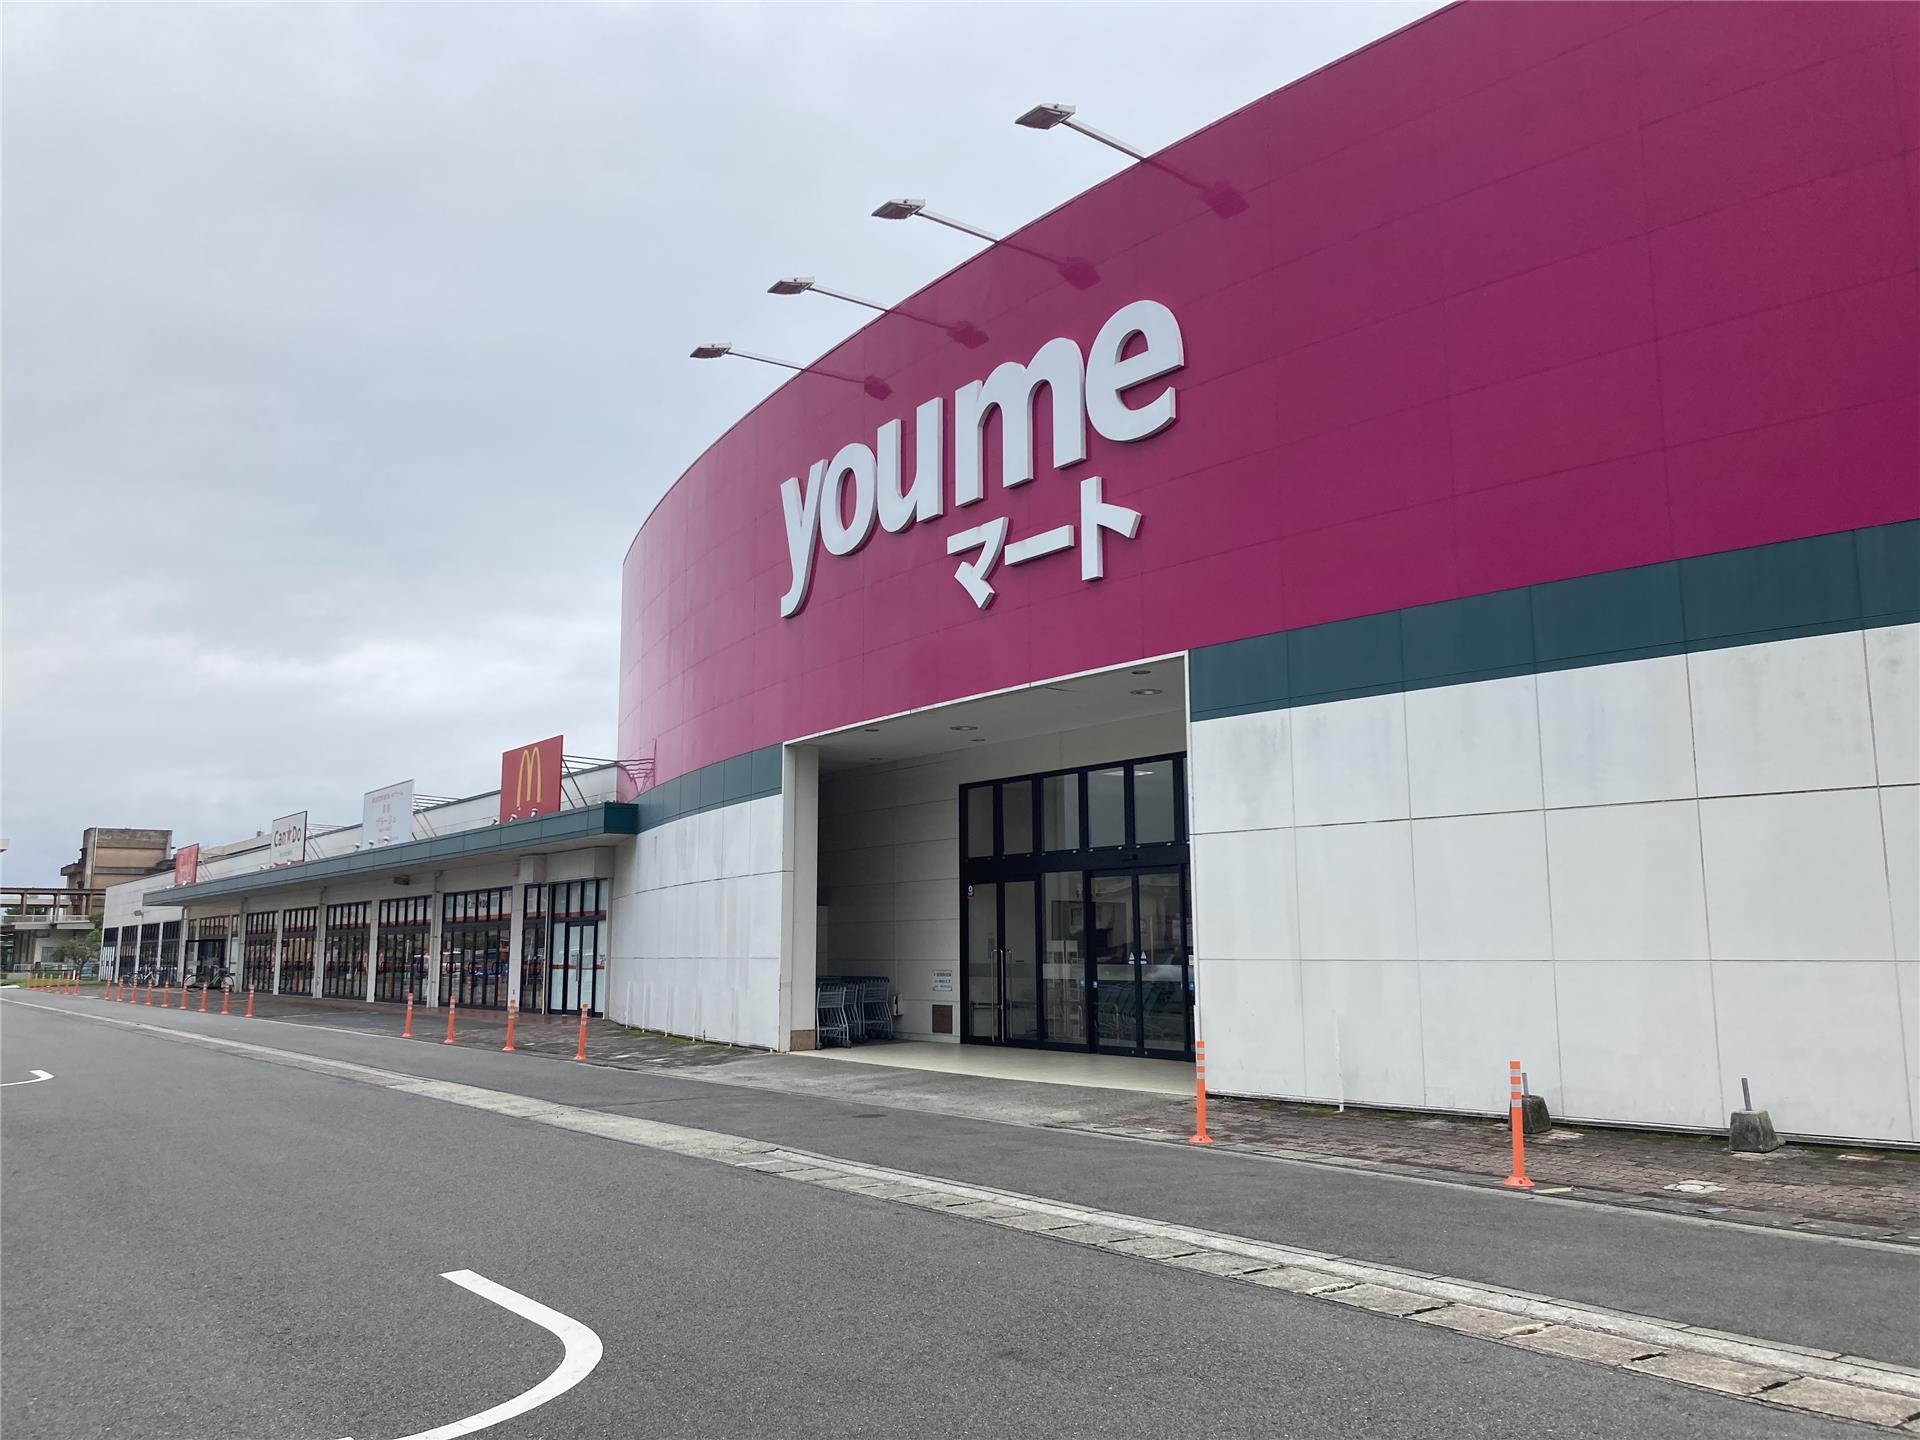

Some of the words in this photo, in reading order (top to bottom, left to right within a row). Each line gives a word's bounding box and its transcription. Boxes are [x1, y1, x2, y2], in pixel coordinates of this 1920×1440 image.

[780, 300, 1184, 618] youme
[947, 476, 1142, 610] マート
